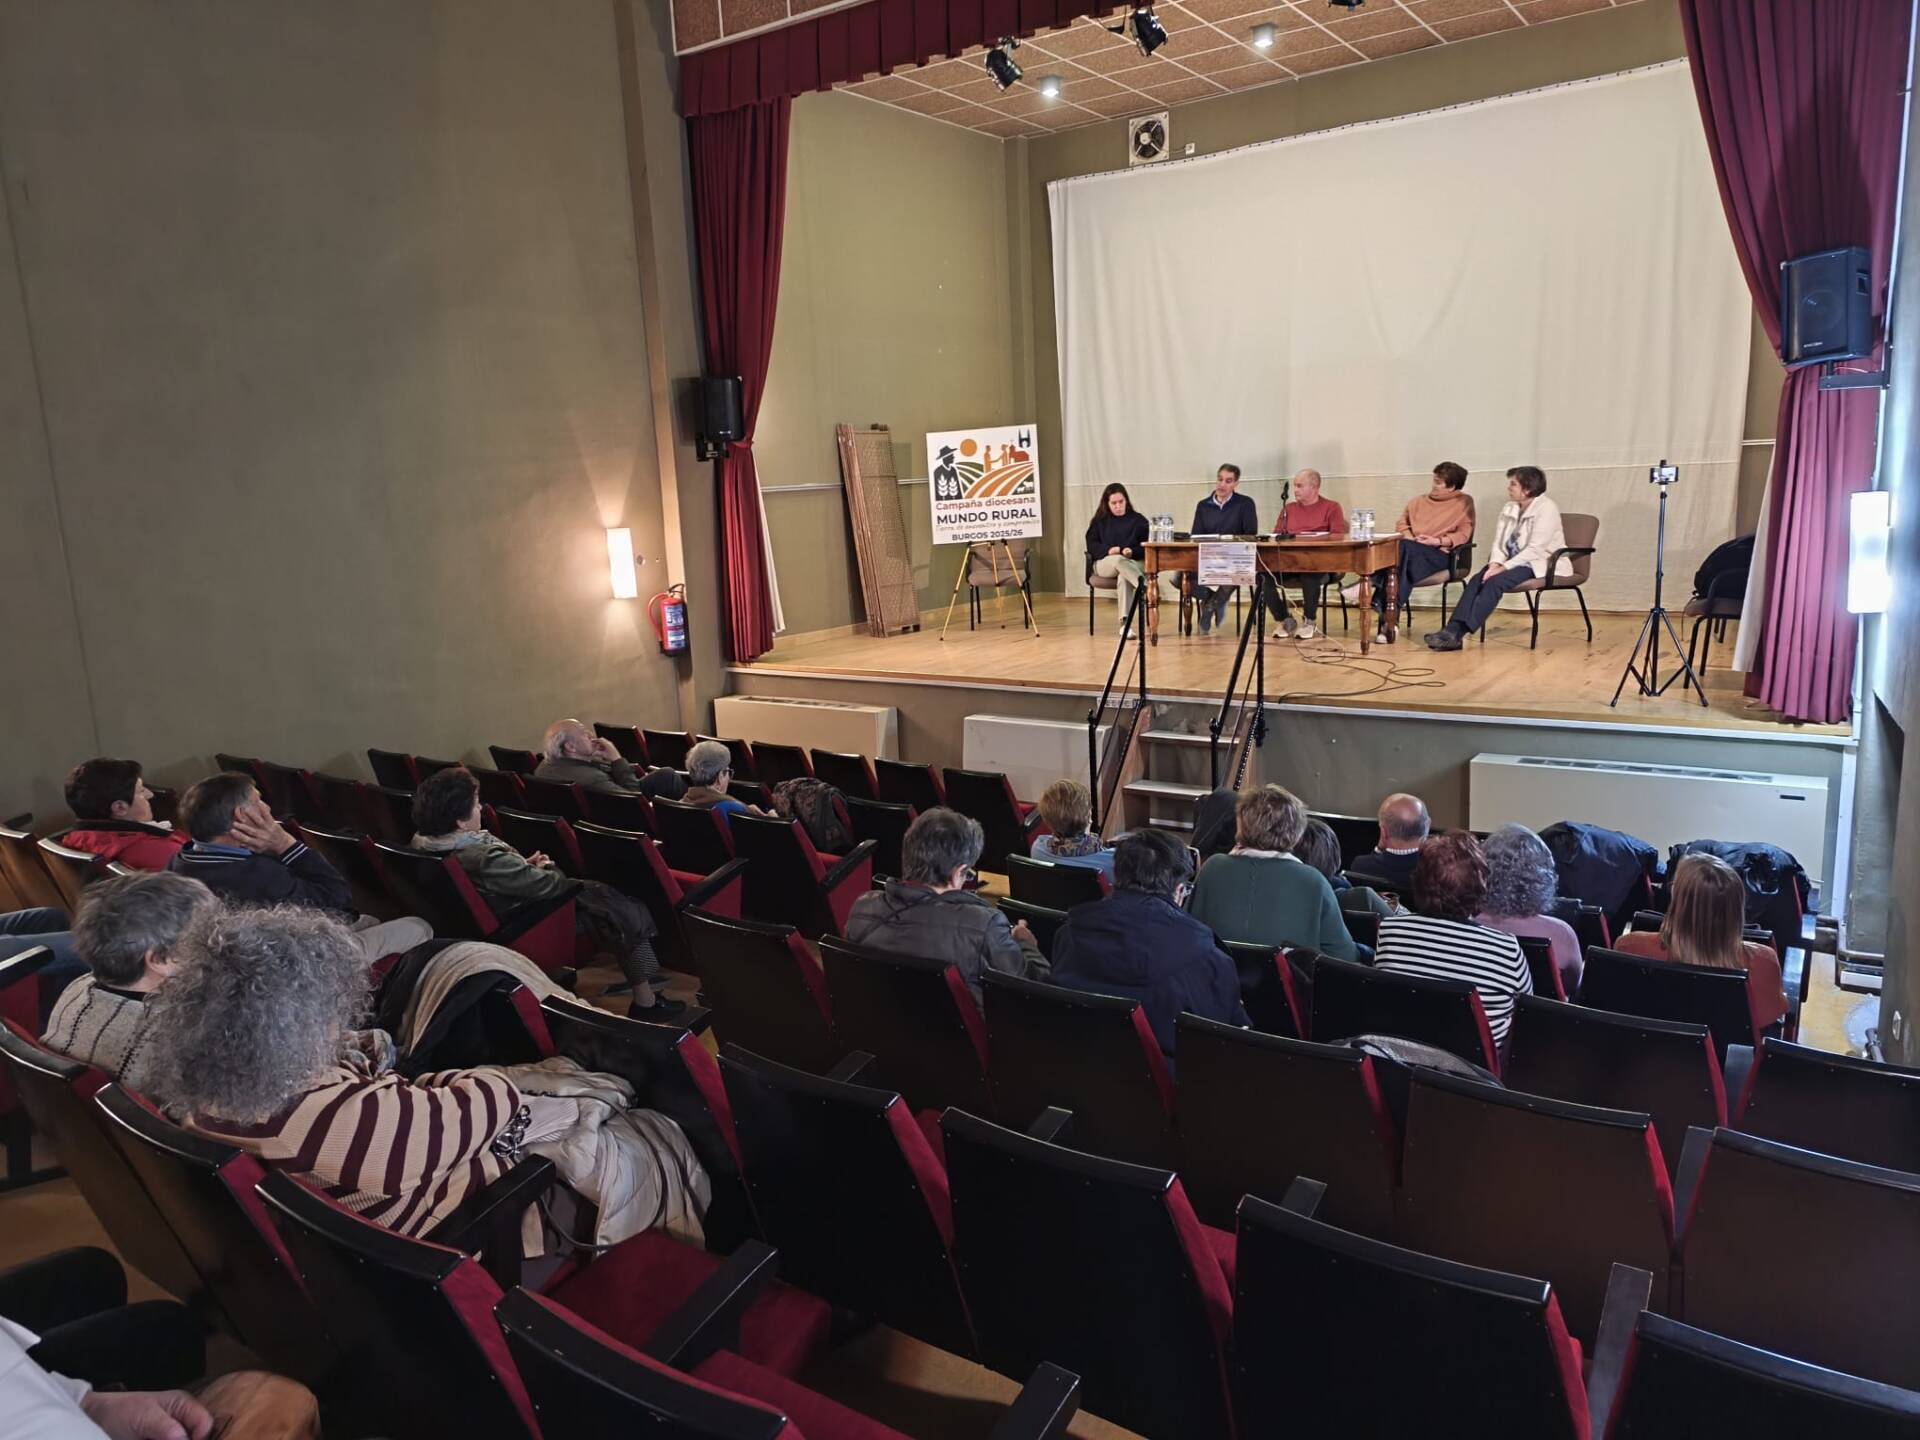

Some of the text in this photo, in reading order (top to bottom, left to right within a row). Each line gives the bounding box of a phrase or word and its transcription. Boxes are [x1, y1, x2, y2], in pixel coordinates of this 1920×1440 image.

[936, 497, 1036, 510] Campaña diocesana
[937, 508, 1036, 524] MUNDO RURAL
[952, 529, 1024, 540] BURGOS 2025/26
